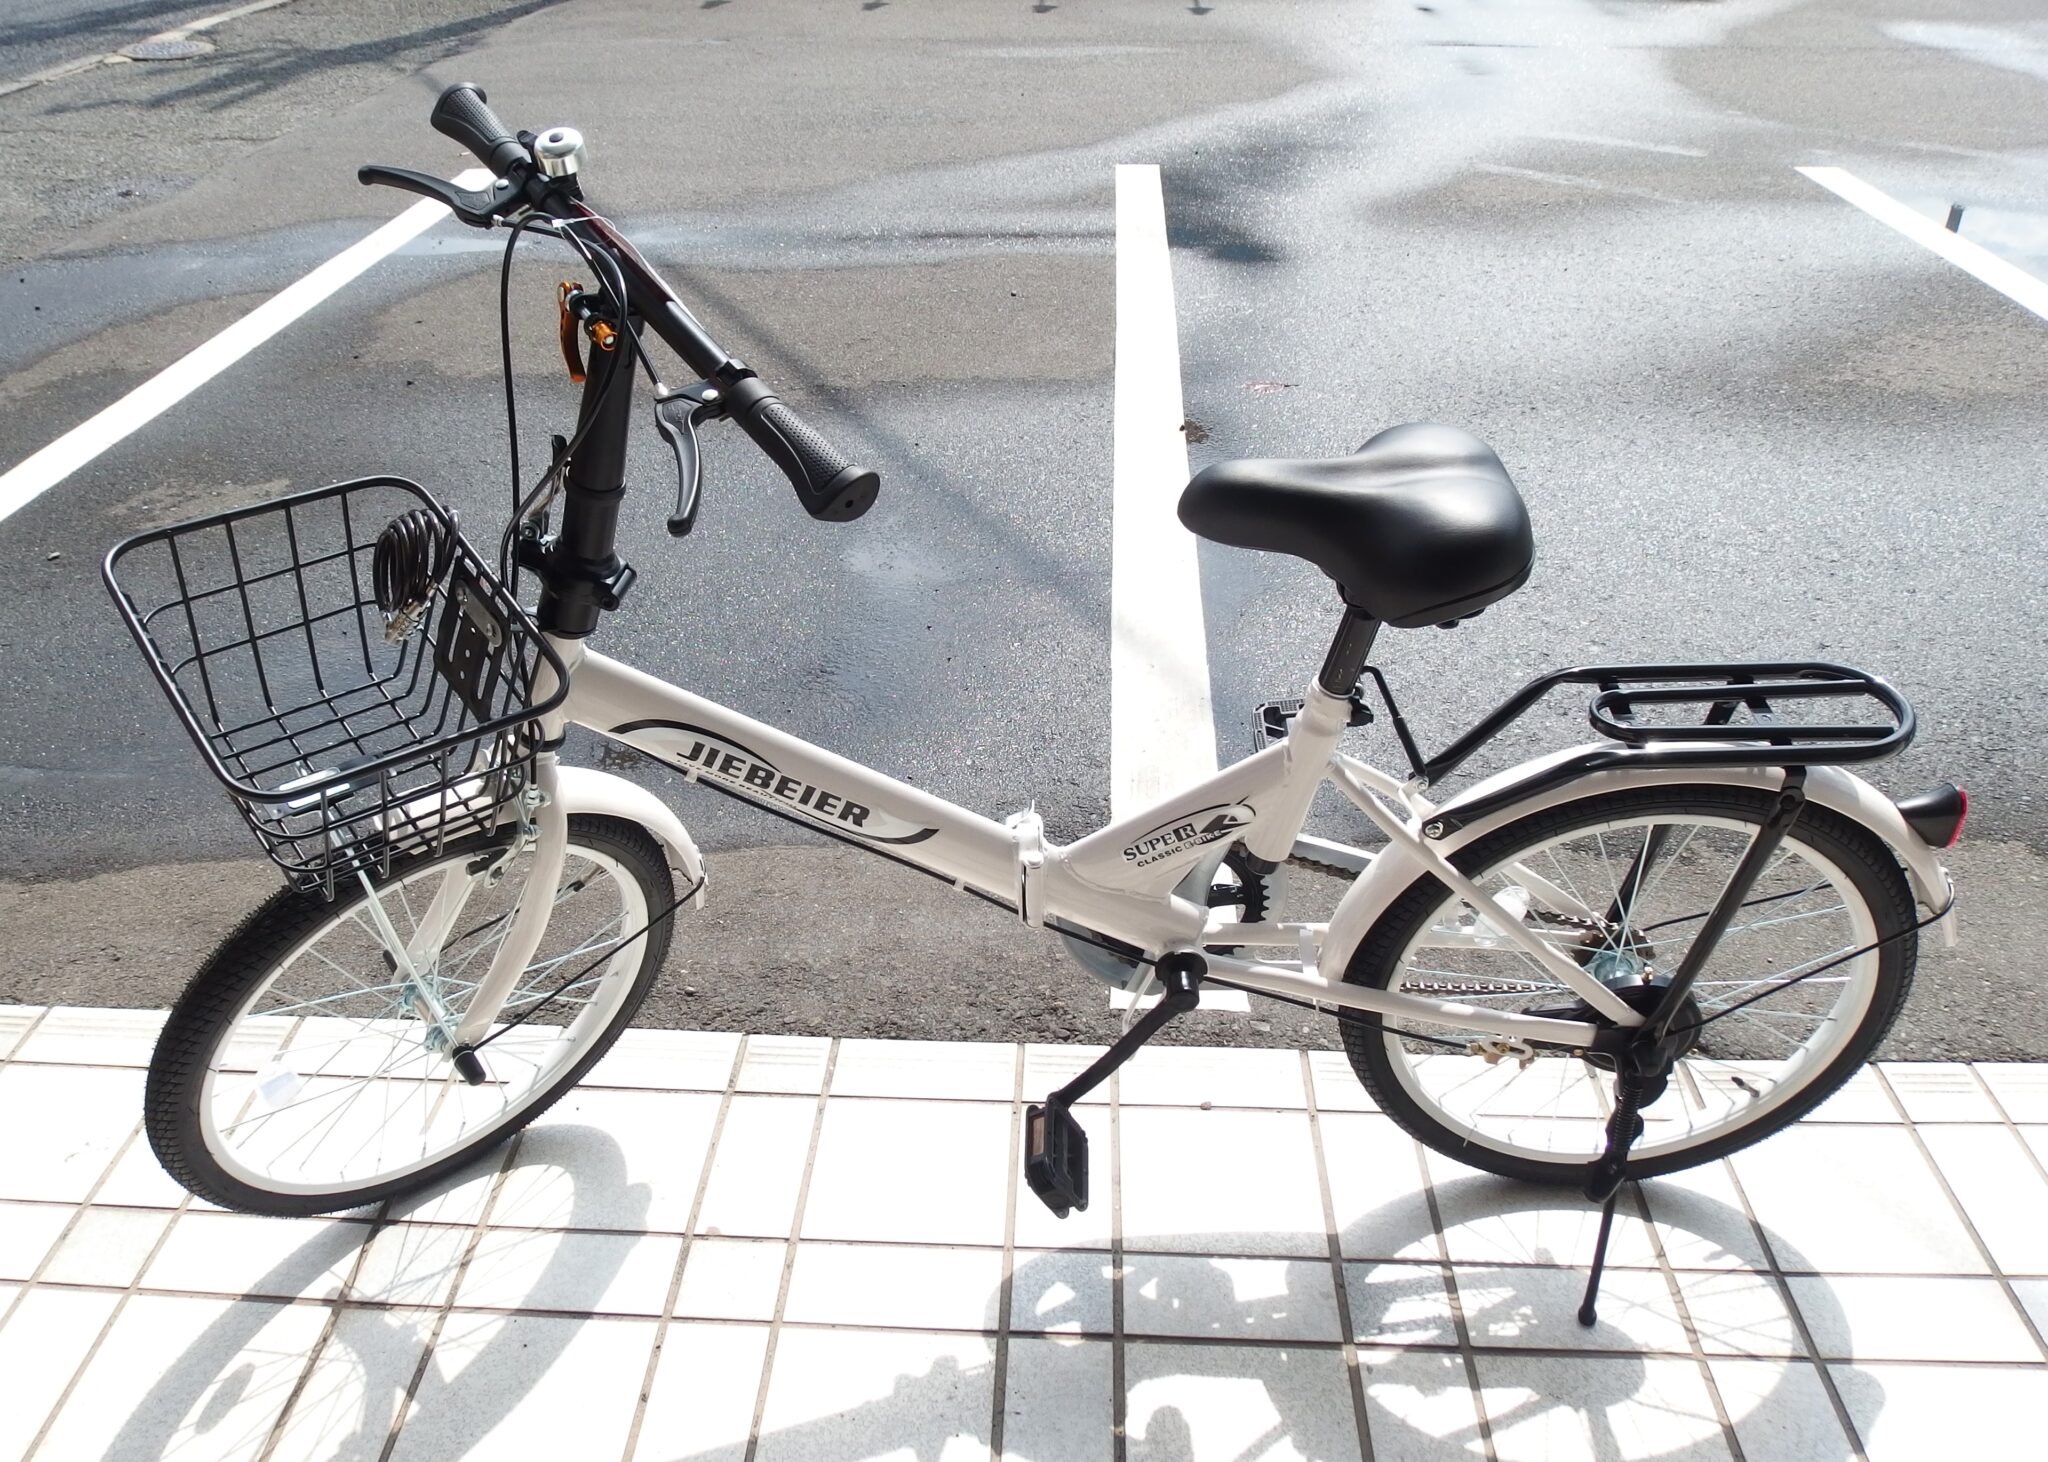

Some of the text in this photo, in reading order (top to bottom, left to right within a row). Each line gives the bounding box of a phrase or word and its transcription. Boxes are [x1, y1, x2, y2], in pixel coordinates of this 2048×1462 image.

[676, 741, 870, 828] JIEBEIER
[705, 769, 736, 784] MORE
[1123, 823, 1197, 861] SUPER
[1137, 846, 1182, 867] CLASSIC
